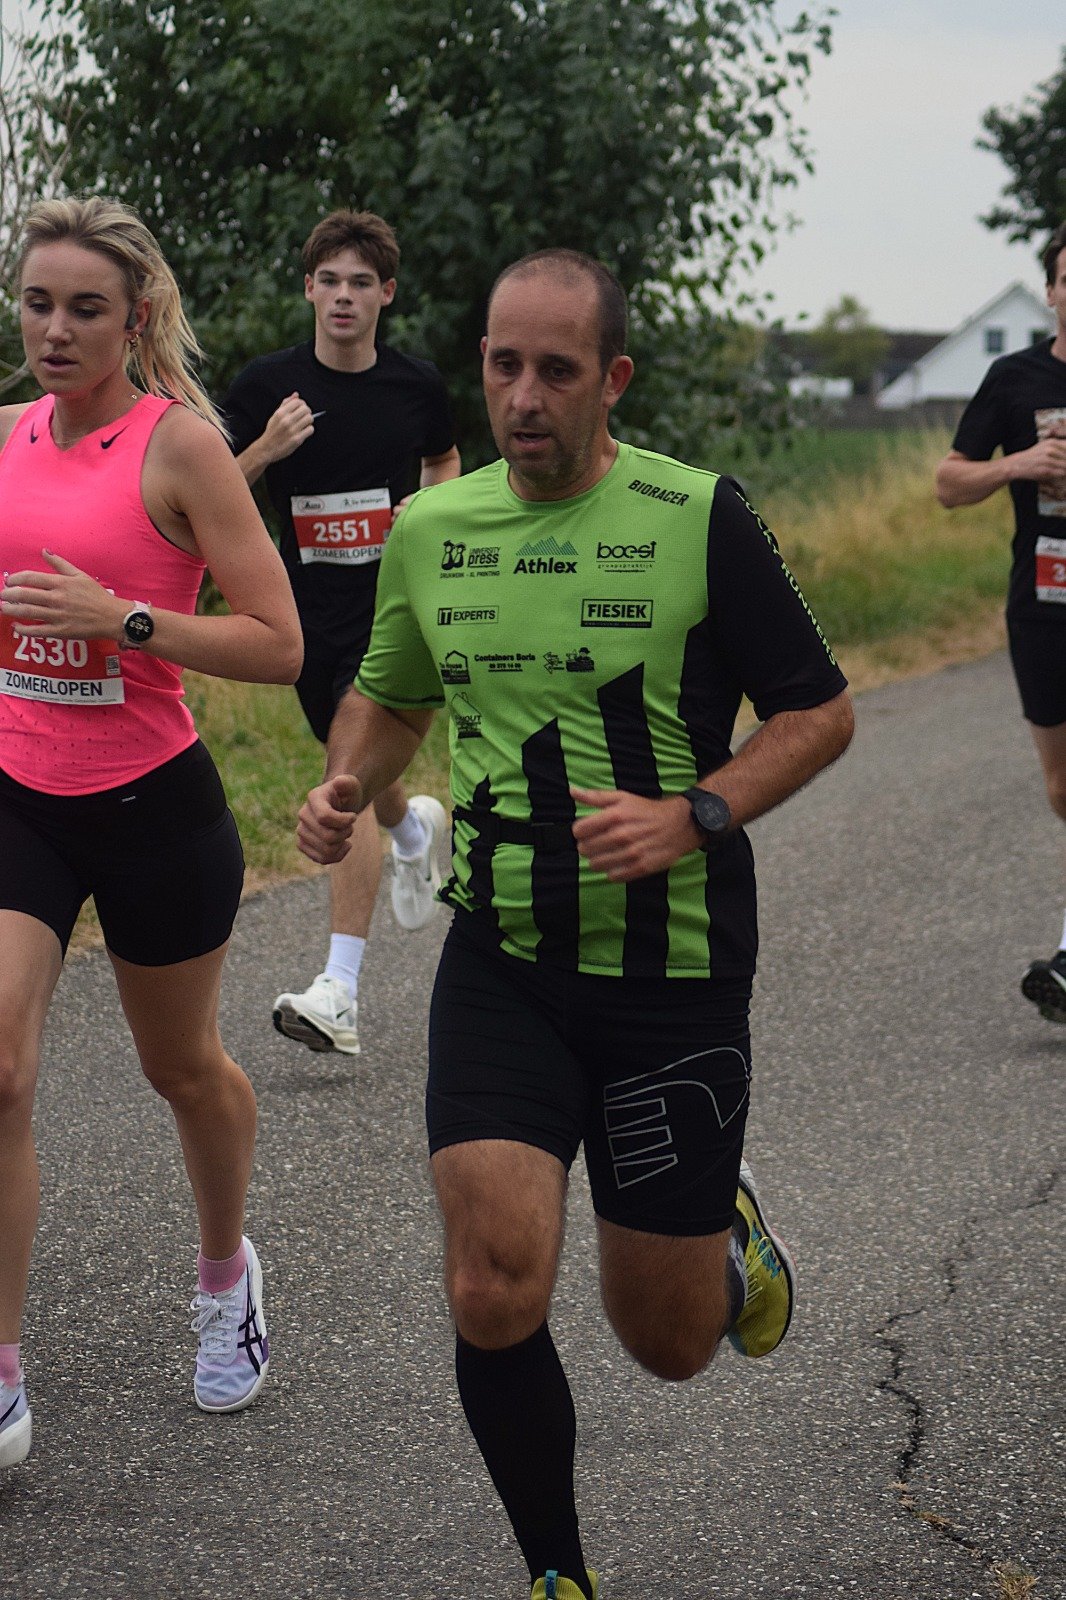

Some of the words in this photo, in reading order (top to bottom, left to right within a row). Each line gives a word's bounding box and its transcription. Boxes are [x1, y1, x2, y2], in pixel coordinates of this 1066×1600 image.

[628, 479, 690, 507] BIORACER
[313, 518, 371, 543] 2551
[312, 546, 382, 560] ZOMERLOPEN
[467, 553, 499, 568] press
[513, 557, 578, 575] Athlex
[438, 609, 451, 625] IT
[453, 609, 497, 621] EXPERTS
[587, 603, 647, 619] FIESIEK
[13, 631, 89, 668] 2530
[474, 653, 515, 662] Containers
[5, 671, 103, 697] ZOMERLOPEN
